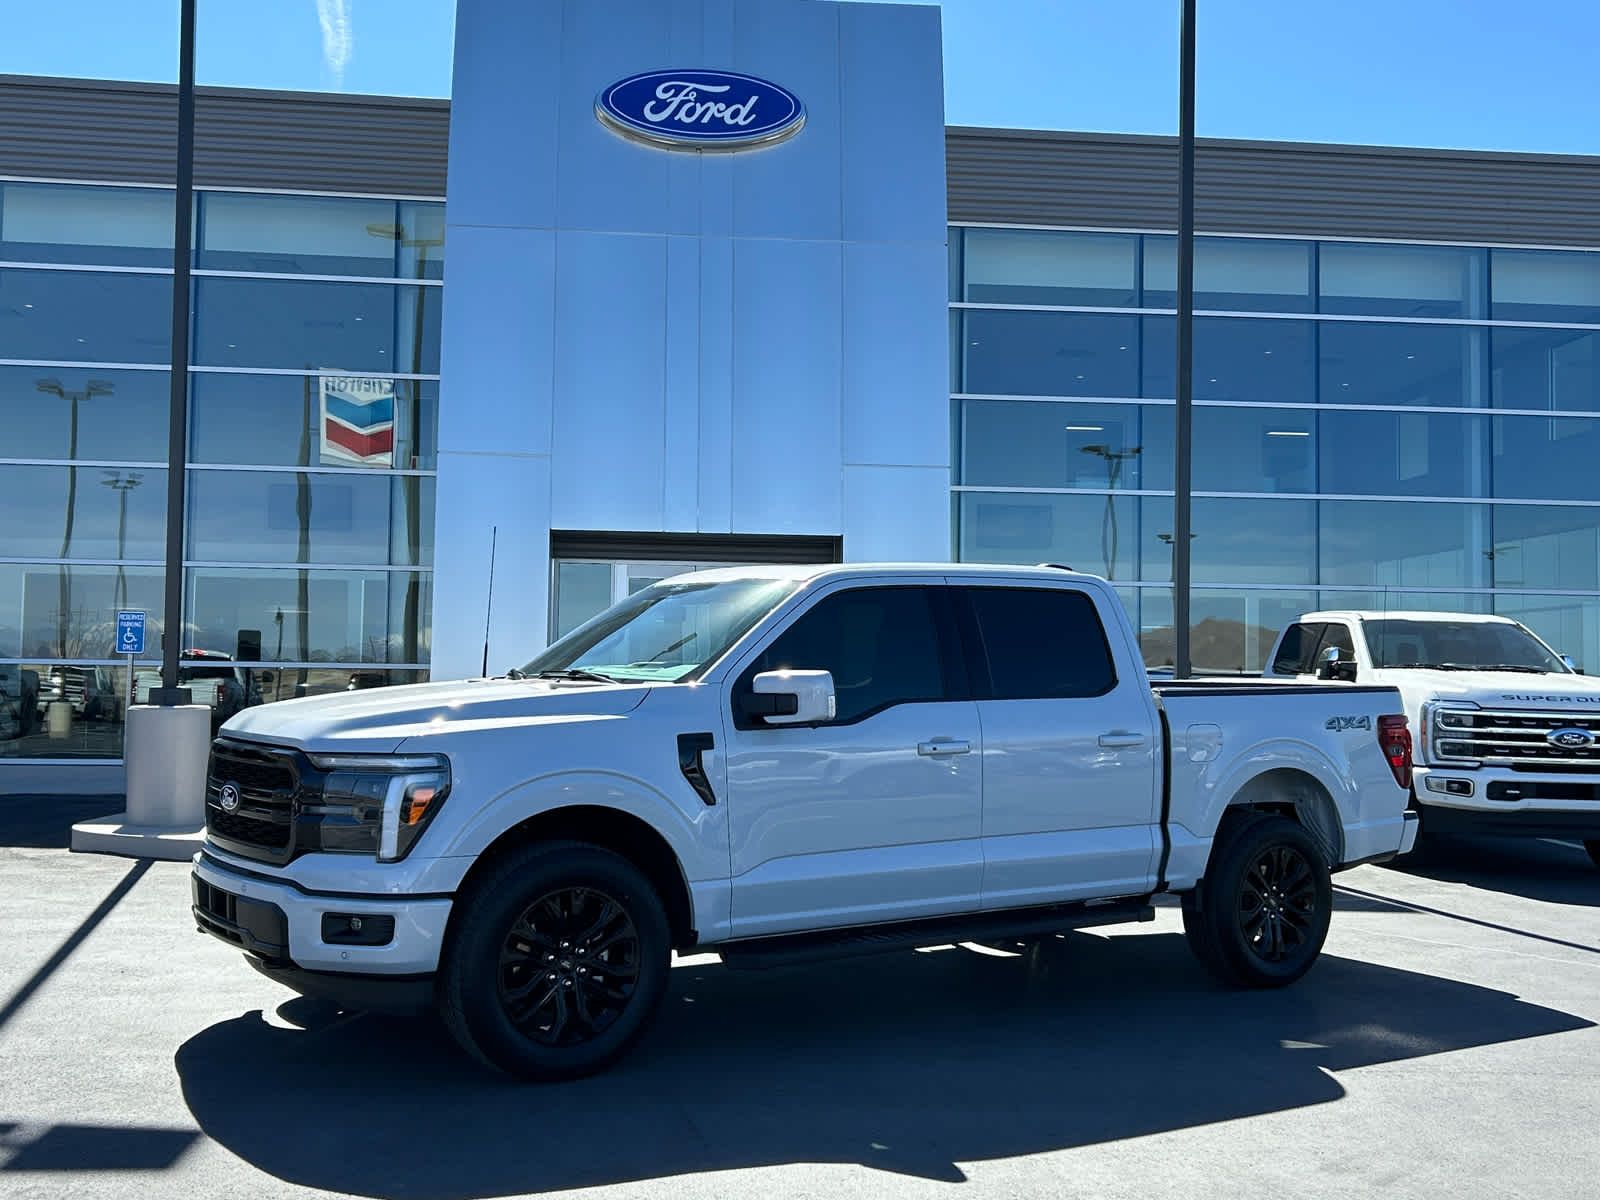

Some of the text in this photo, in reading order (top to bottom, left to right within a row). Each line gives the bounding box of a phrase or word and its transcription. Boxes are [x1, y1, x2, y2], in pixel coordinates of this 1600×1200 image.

[643, 81, 759, 126] Ford
[122, 643, 138, 651] ONLY
[1501, 694, 1572, 703] SUPER
[1561, 733, 1584, 744] Ford
